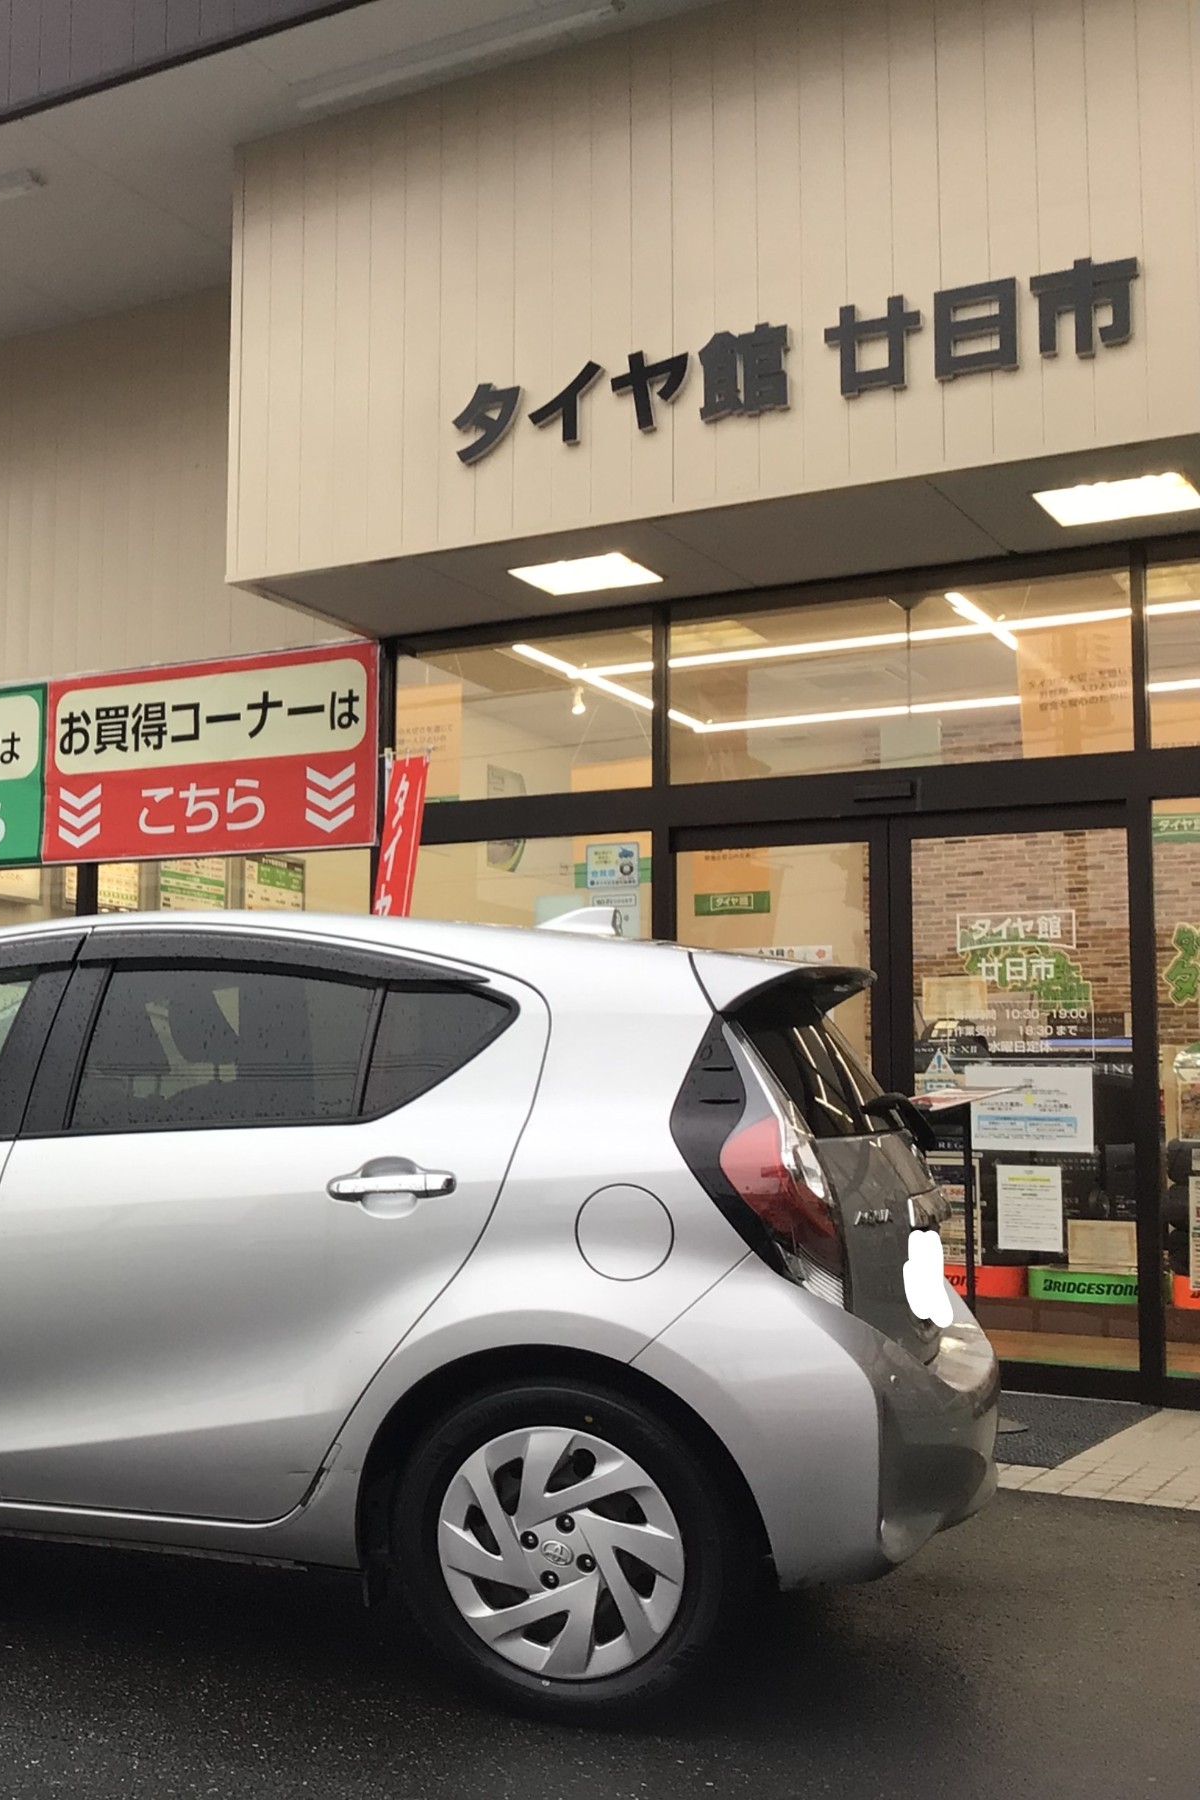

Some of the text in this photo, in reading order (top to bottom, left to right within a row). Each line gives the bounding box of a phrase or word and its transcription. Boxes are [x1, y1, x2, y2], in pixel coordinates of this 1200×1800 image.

[452, 256, 1139, 466] タイヤ館 廿日市
[58, 688, 361, 757] お買得コーナーは
[138, 778, 267, 836] こちら
[971, 915, 1062, 941] タイヤ館
[977, 956, 1056, 981] 廿日市
